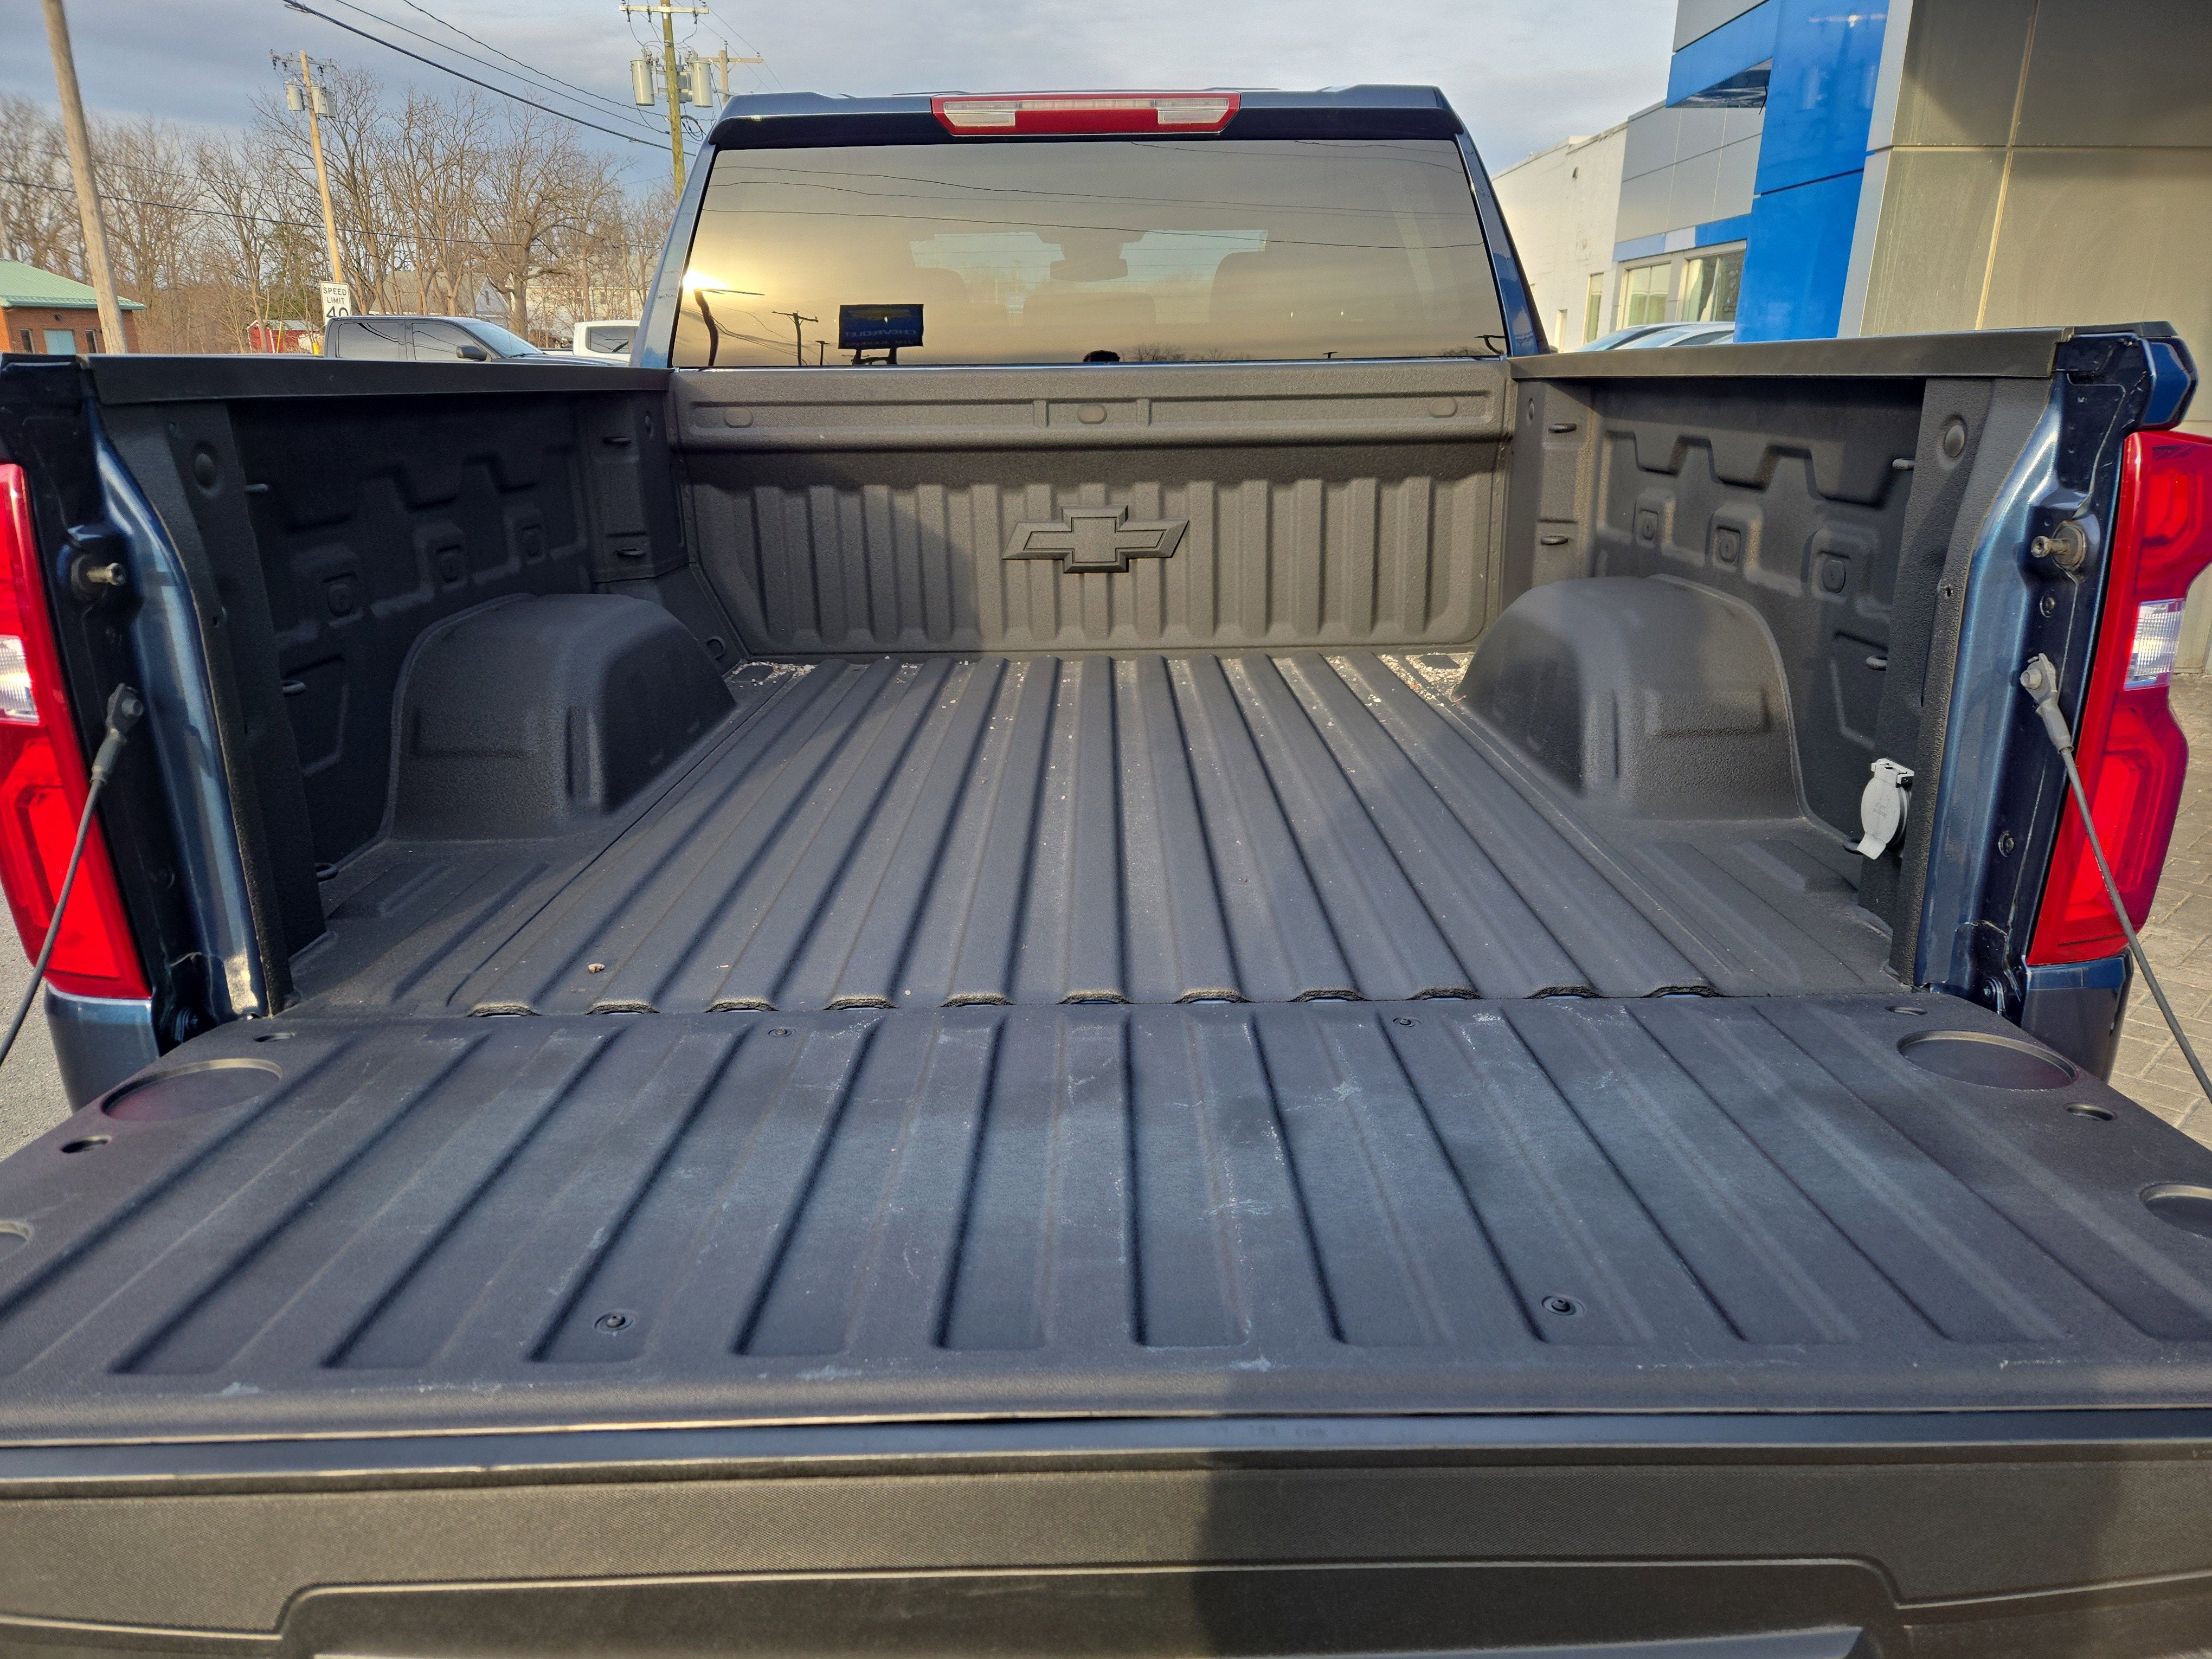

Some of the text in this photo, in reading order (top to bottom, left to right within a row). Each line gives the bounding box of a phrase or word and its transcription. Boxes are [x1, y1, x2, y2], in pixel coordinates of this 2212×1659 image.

[323, 287, 347, 295] SPEED
[326, 297, 345, 305] LIMIT
[326, 306, 349, 317] 40
